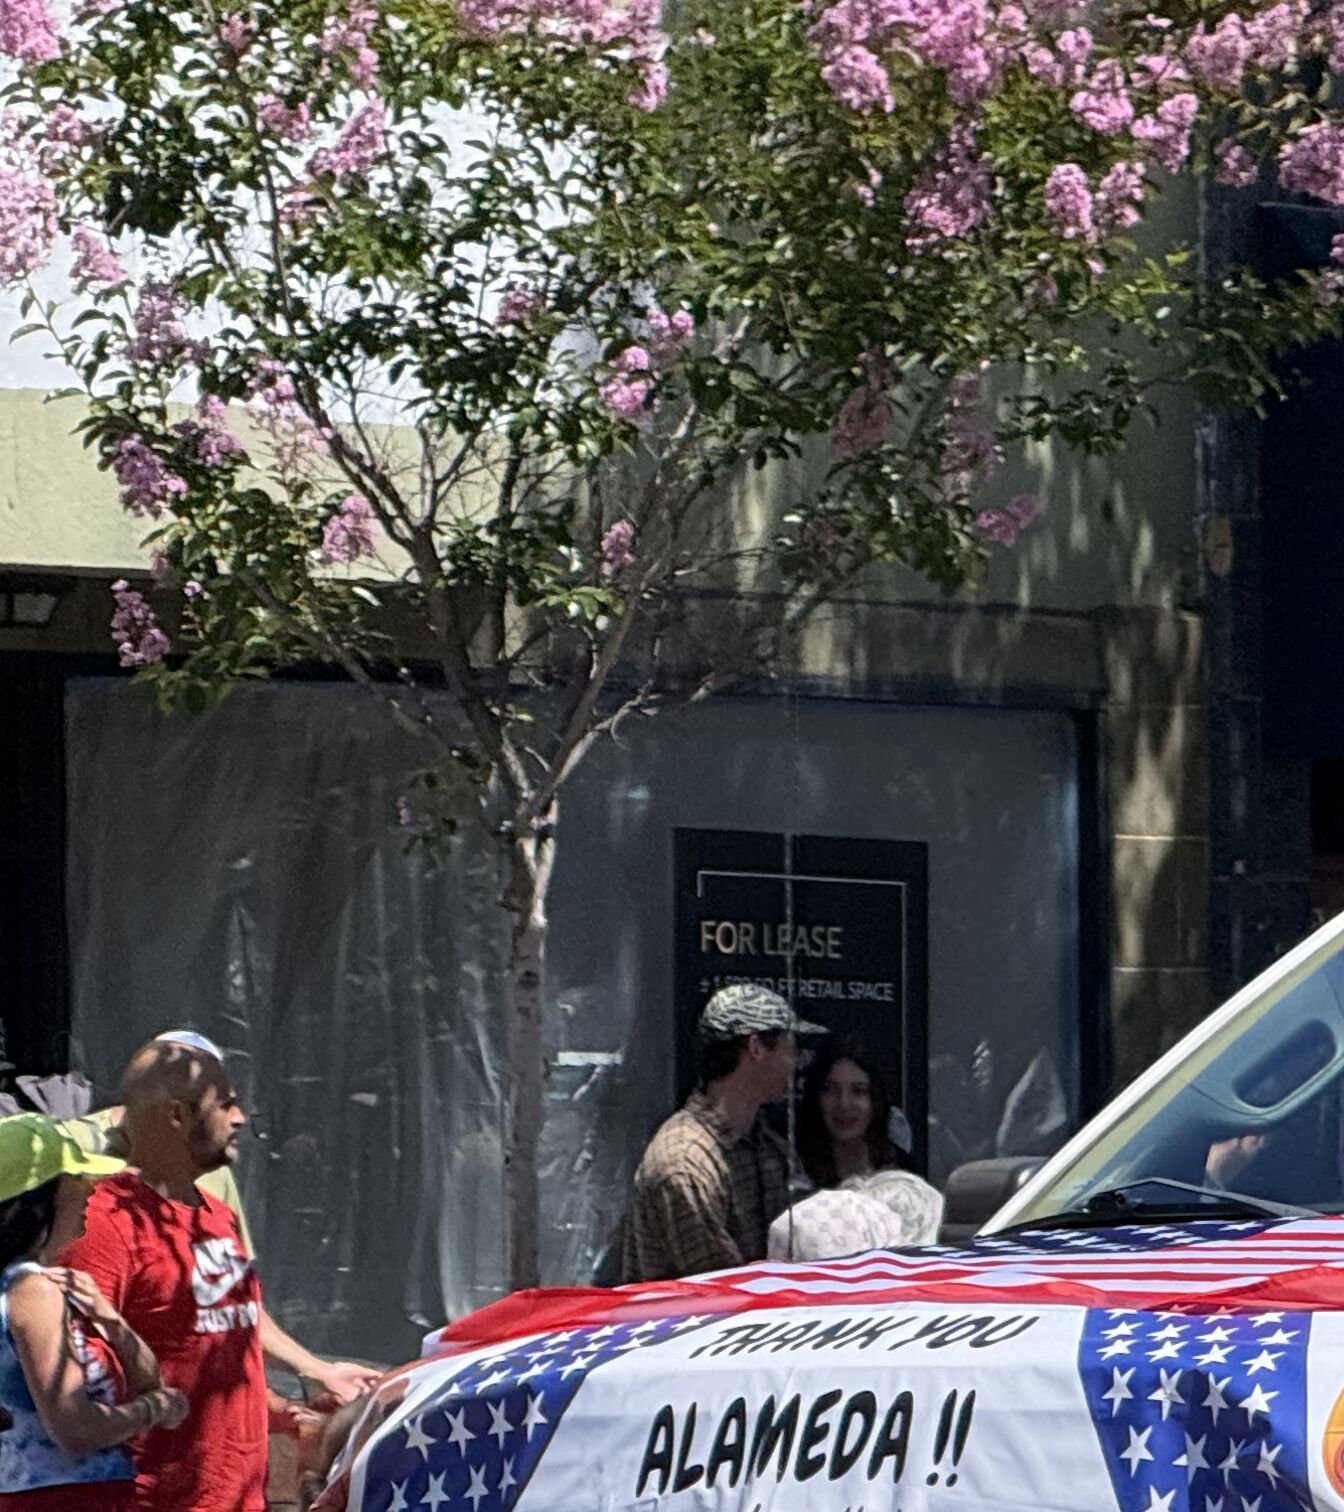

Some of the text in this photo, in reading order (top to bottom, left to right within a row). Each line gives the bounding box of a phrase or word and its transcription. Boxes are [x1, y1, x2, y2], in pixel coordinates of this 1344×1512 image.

[701, 920, 843, 959] FOR LEASE
[799, 979, 847, 999] RETAIL
[689, 1314, 1040, 1359] THANK YOU
[636, 1388, 976, 1498] ALAMEDA !!
